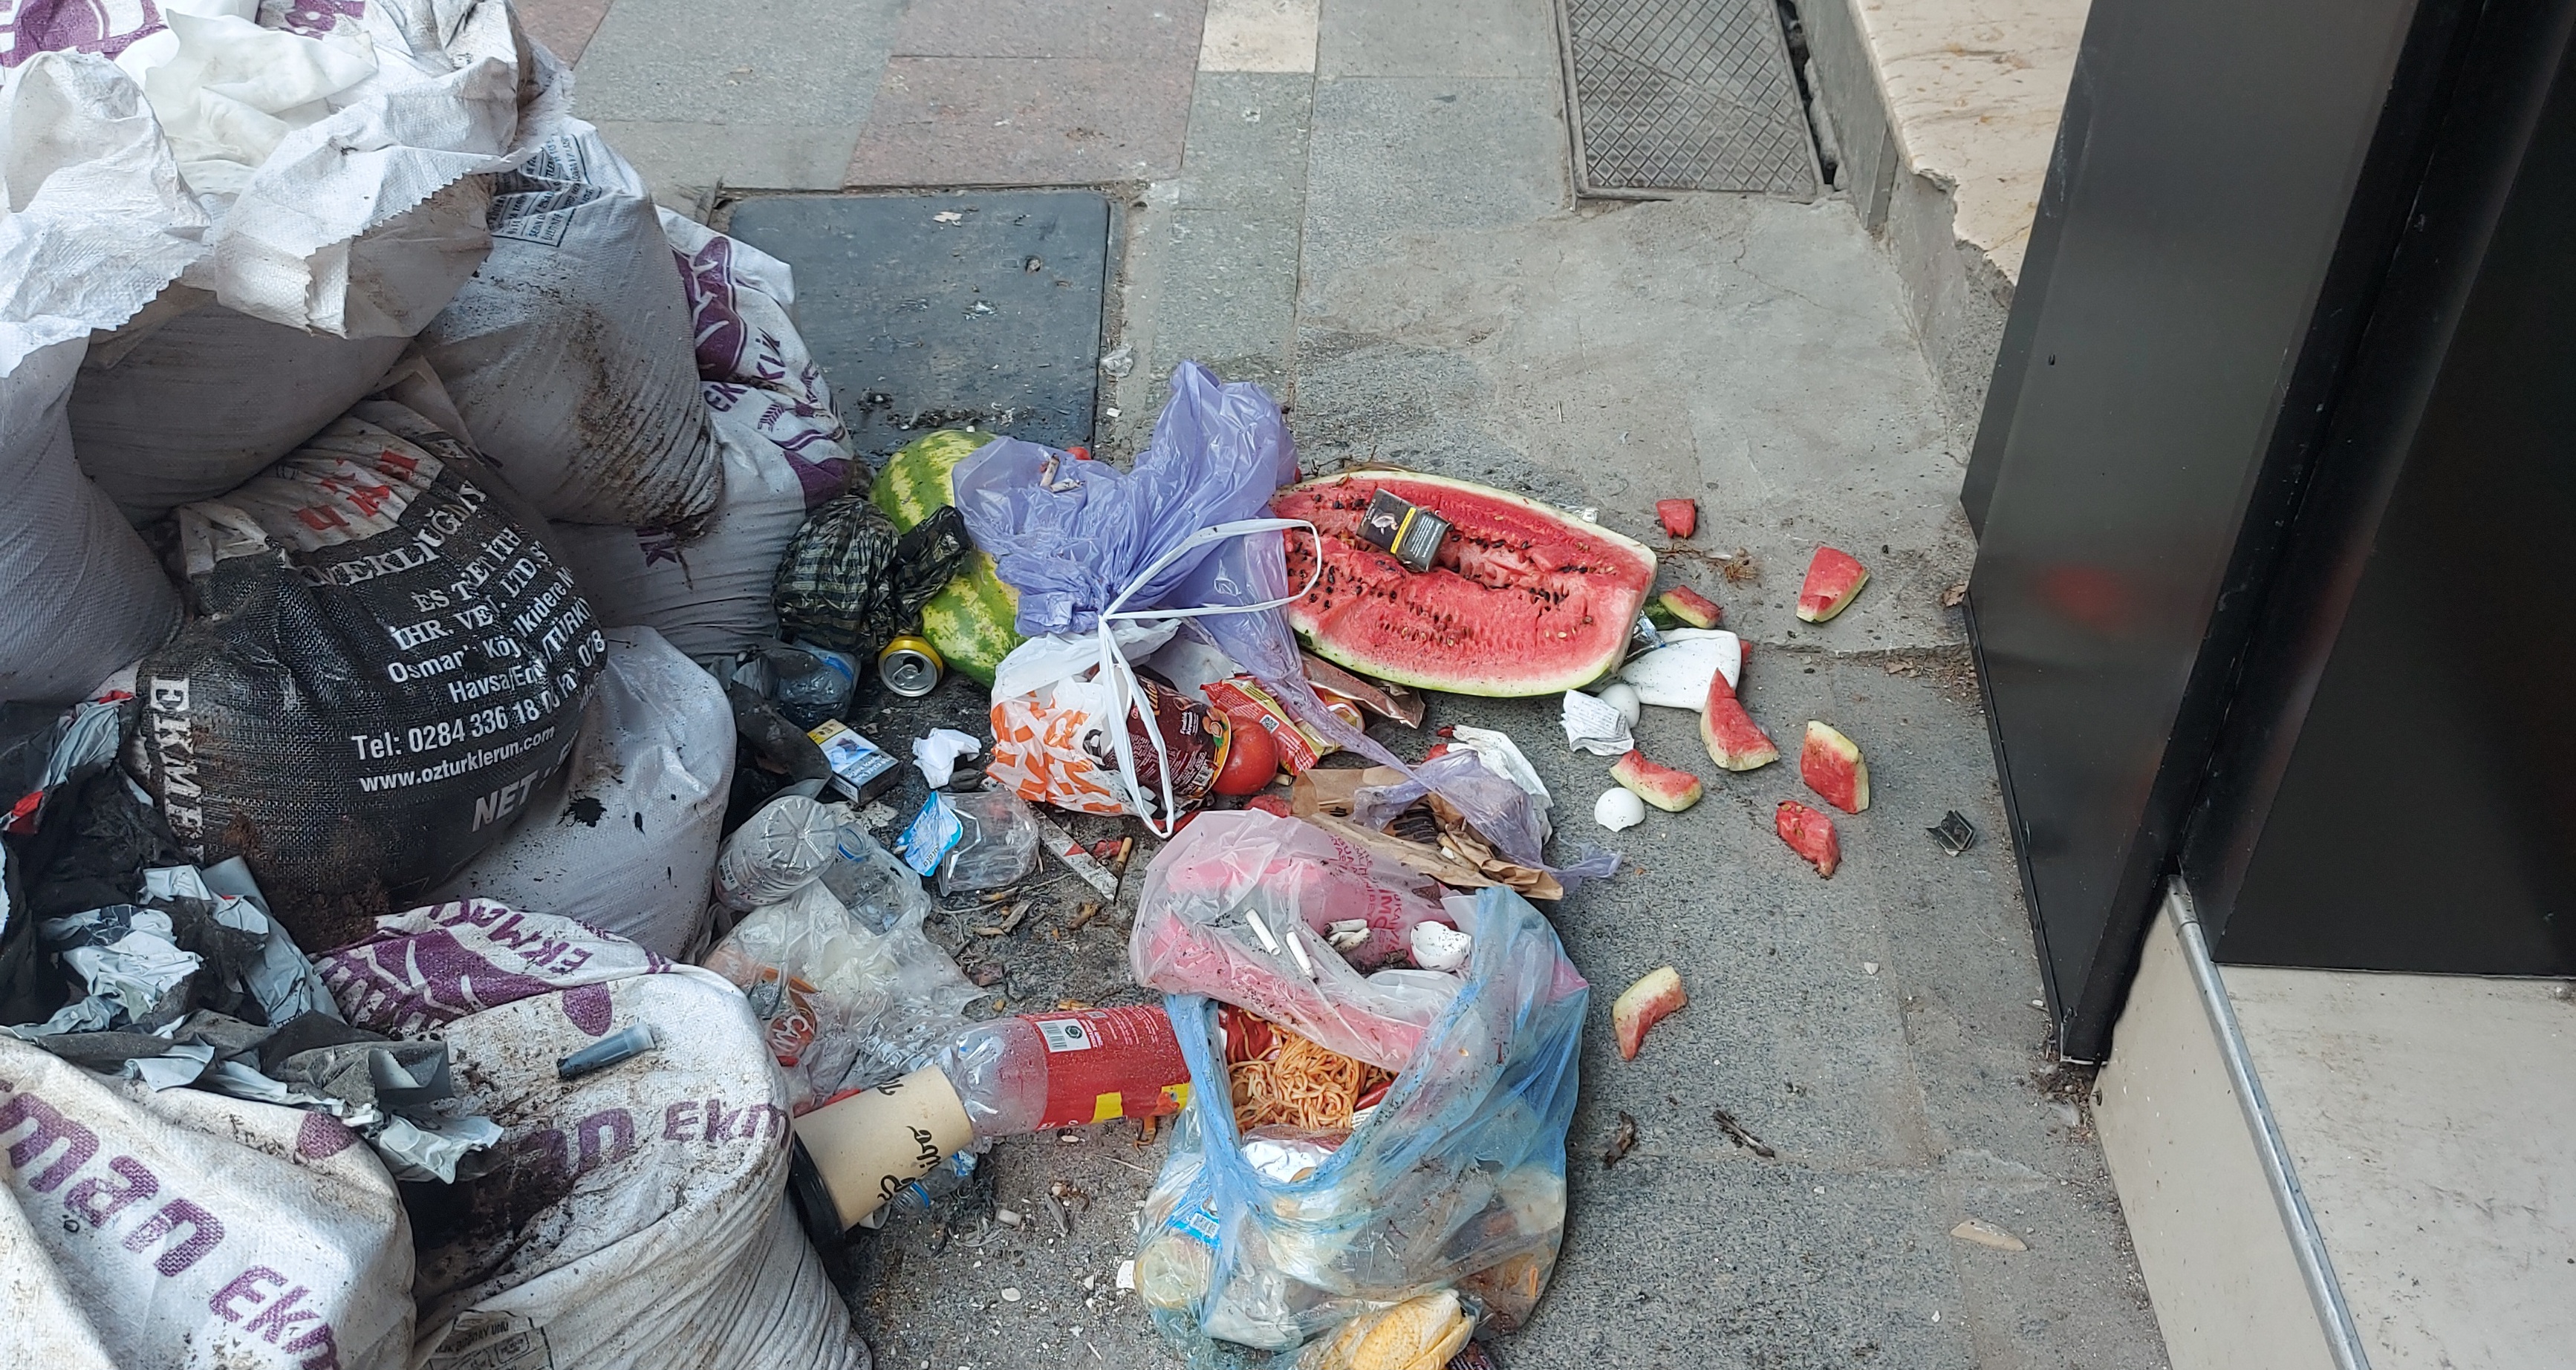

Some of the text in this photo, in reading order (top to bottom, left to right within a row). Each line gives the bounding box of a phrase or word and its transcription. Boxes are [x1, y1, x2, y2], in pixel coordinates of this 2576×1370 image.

[352, 732, 403, 760] Tel:
[409, 719, 465, 753] 0284
[470, 705, 509, 737] 336
[512, 699, 540, 724] 18
